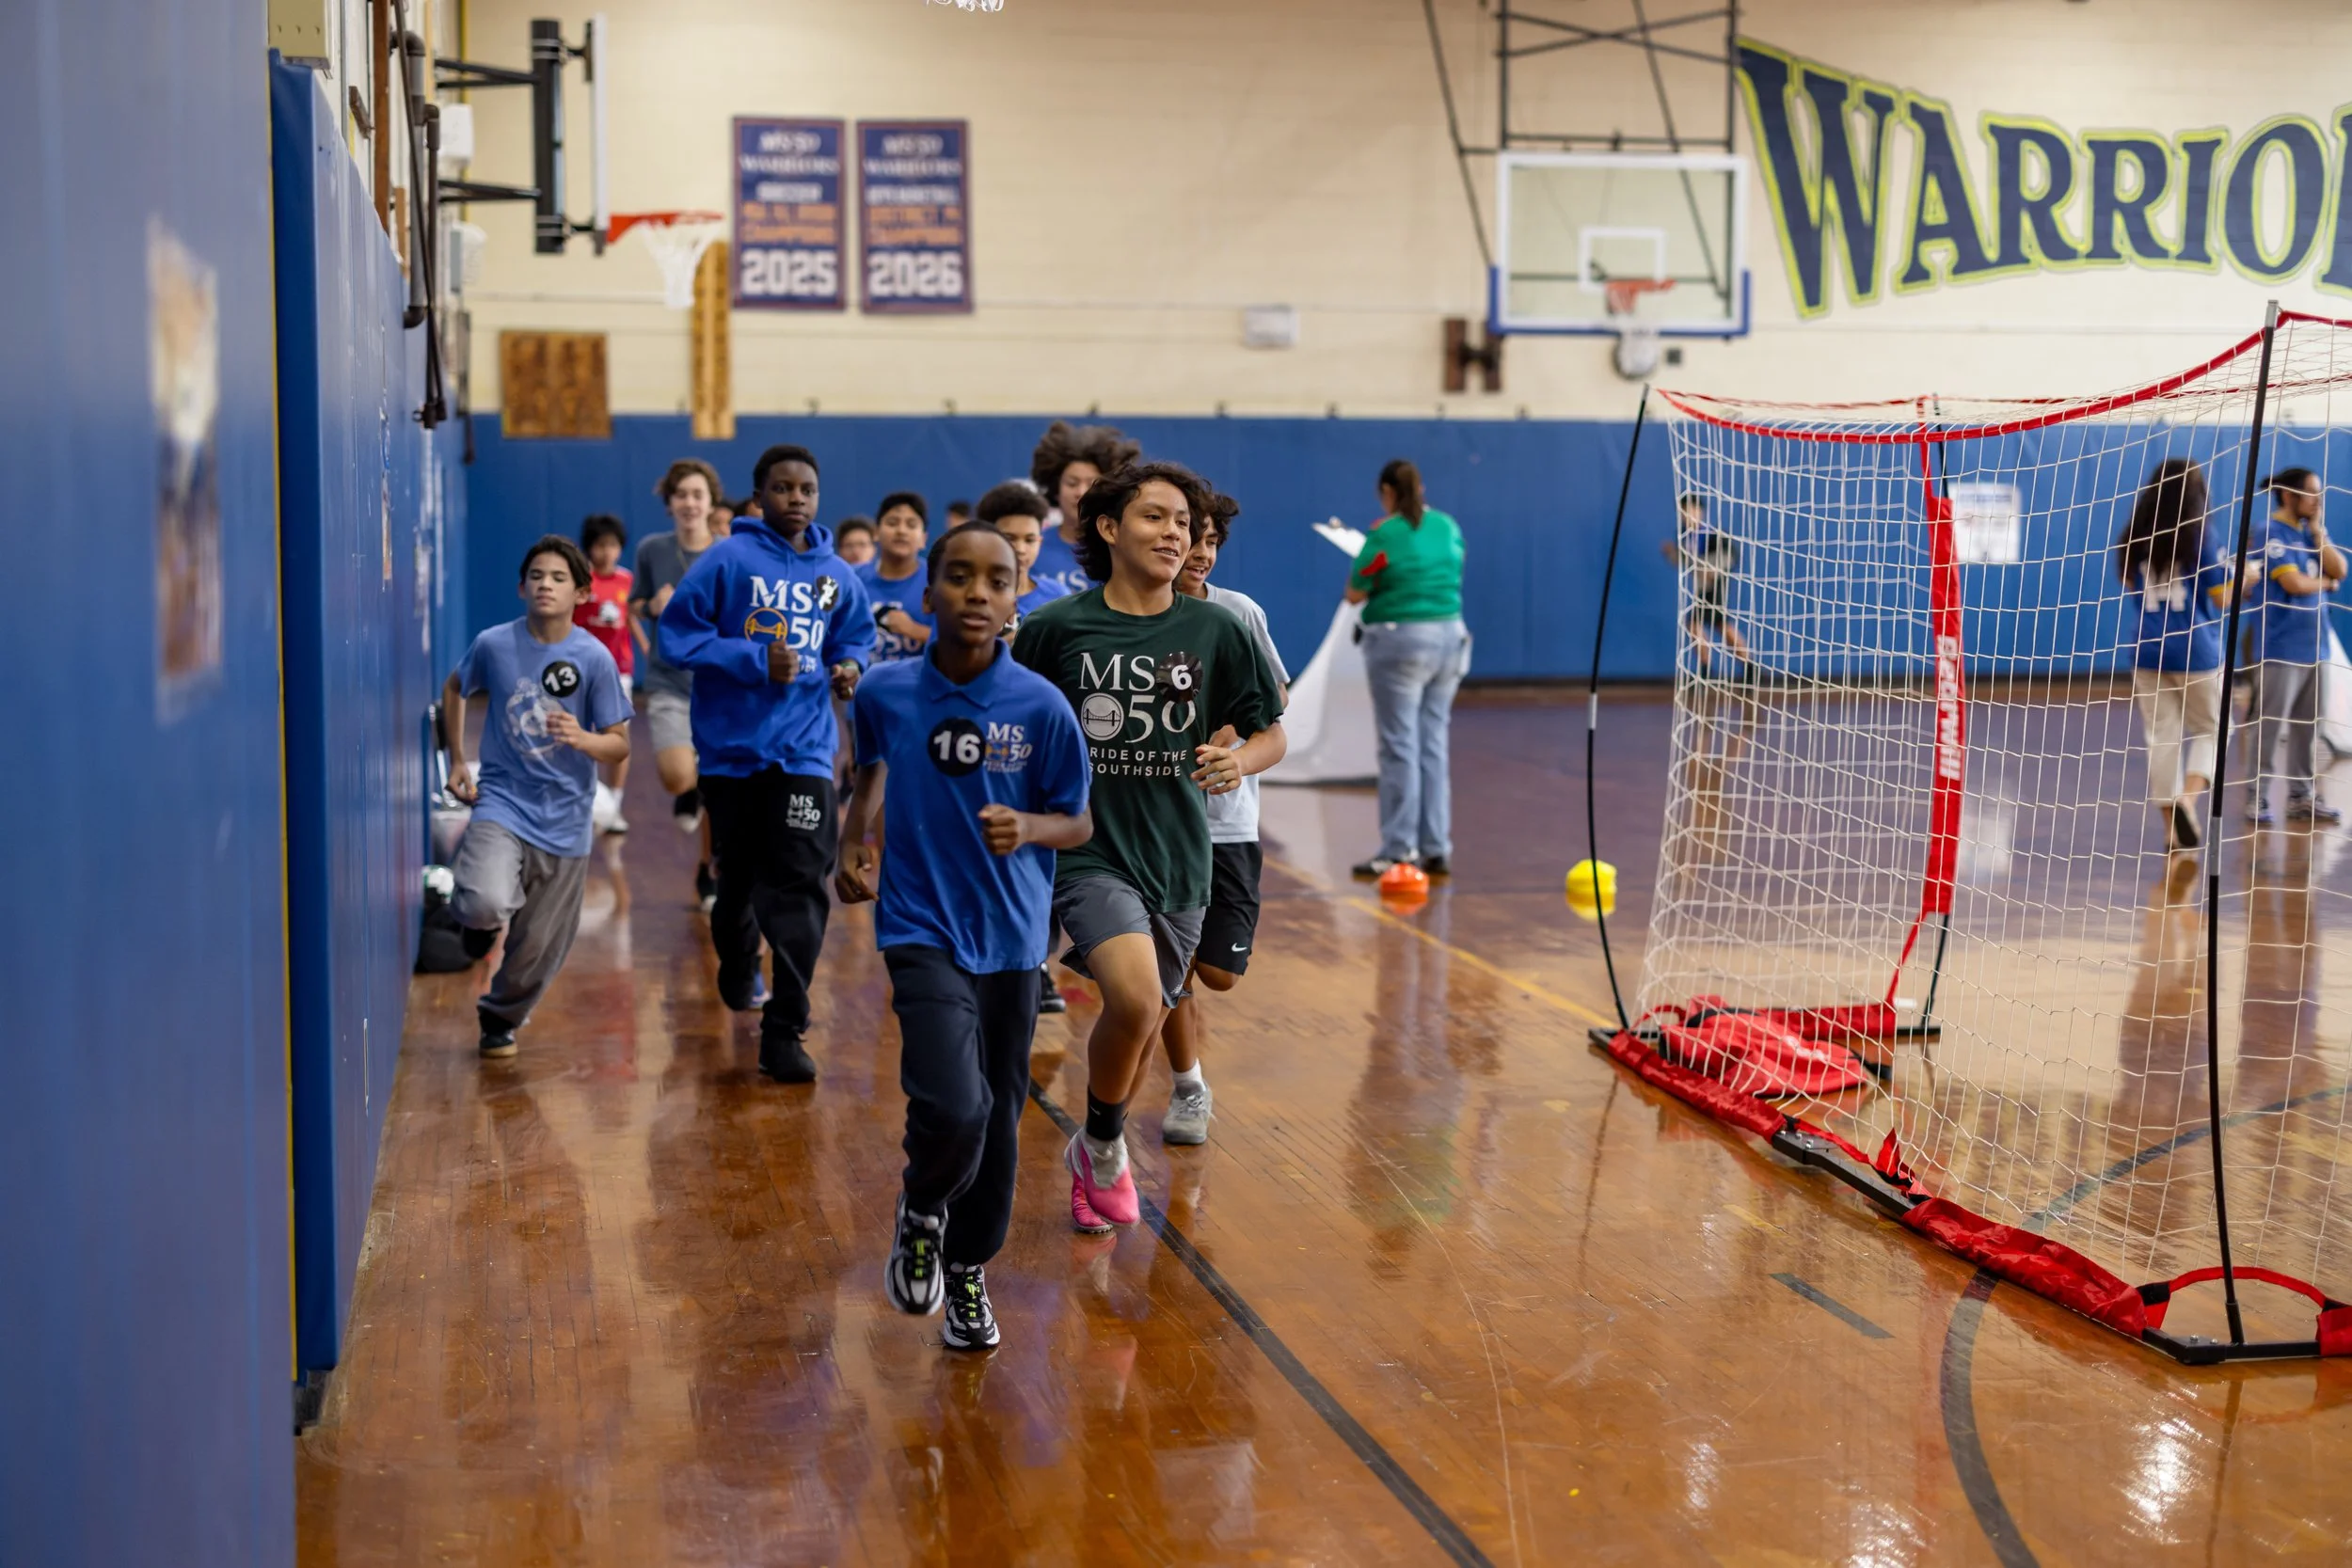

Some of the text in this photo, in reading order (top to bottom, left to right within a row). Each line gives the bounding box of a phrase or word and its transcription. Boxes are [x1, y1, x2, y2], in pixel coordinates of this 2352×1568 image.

[740, 249, 837, 295] 2025
[866, 252, 963, 297] 2026
[750, 576, 813, 613] MS
[787, 616, 824, 651] 50
[545, 666, 578, 692] 13
[1078, 653, 1155, 691] MS
[1171, 664, 1192, 690] 6
[986, 721, 1025, 743] MS
[1125, 695, 1196, 743] 50
[933, 729, 981, 765] 16
[1009, 744, 1032, 762] 50
[1089, 747, 1186, 762] RIDE OF THE
[1088, 763, 1181, 777] SOUTHSIDE
[789, 794, 814, 808] MS
[803, 808, 821, 822] 50
